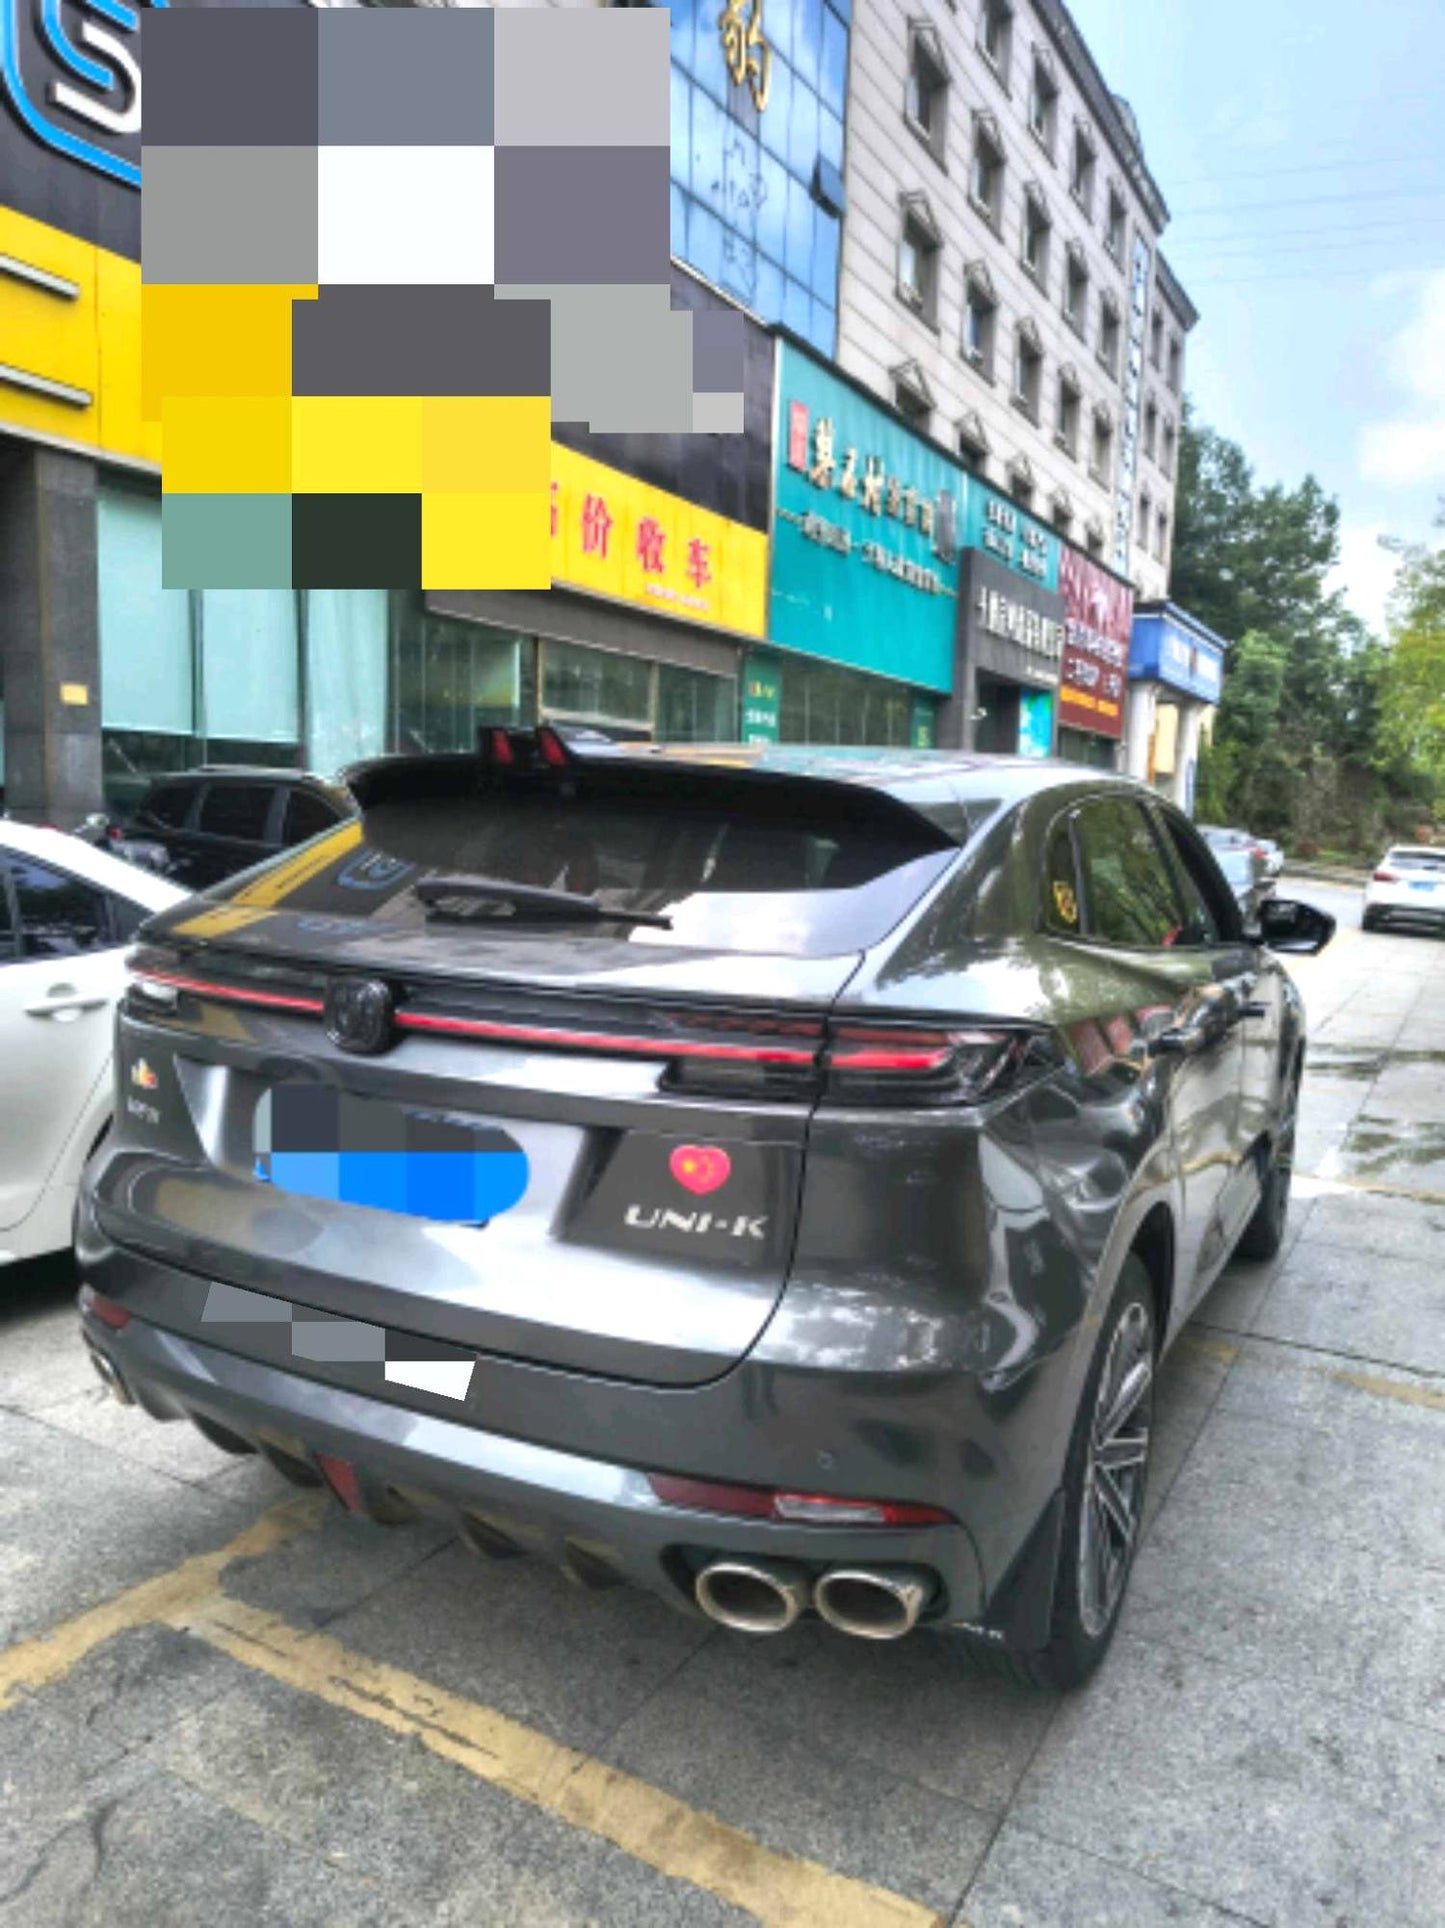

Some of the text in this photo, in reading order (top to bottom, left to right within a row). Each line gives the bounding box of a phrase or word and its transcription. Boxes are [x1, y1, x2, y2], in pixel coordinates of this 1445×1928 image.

[551, 482, 712, 589] 价收车
[624, 1204, 769, 1240] UNI-K
